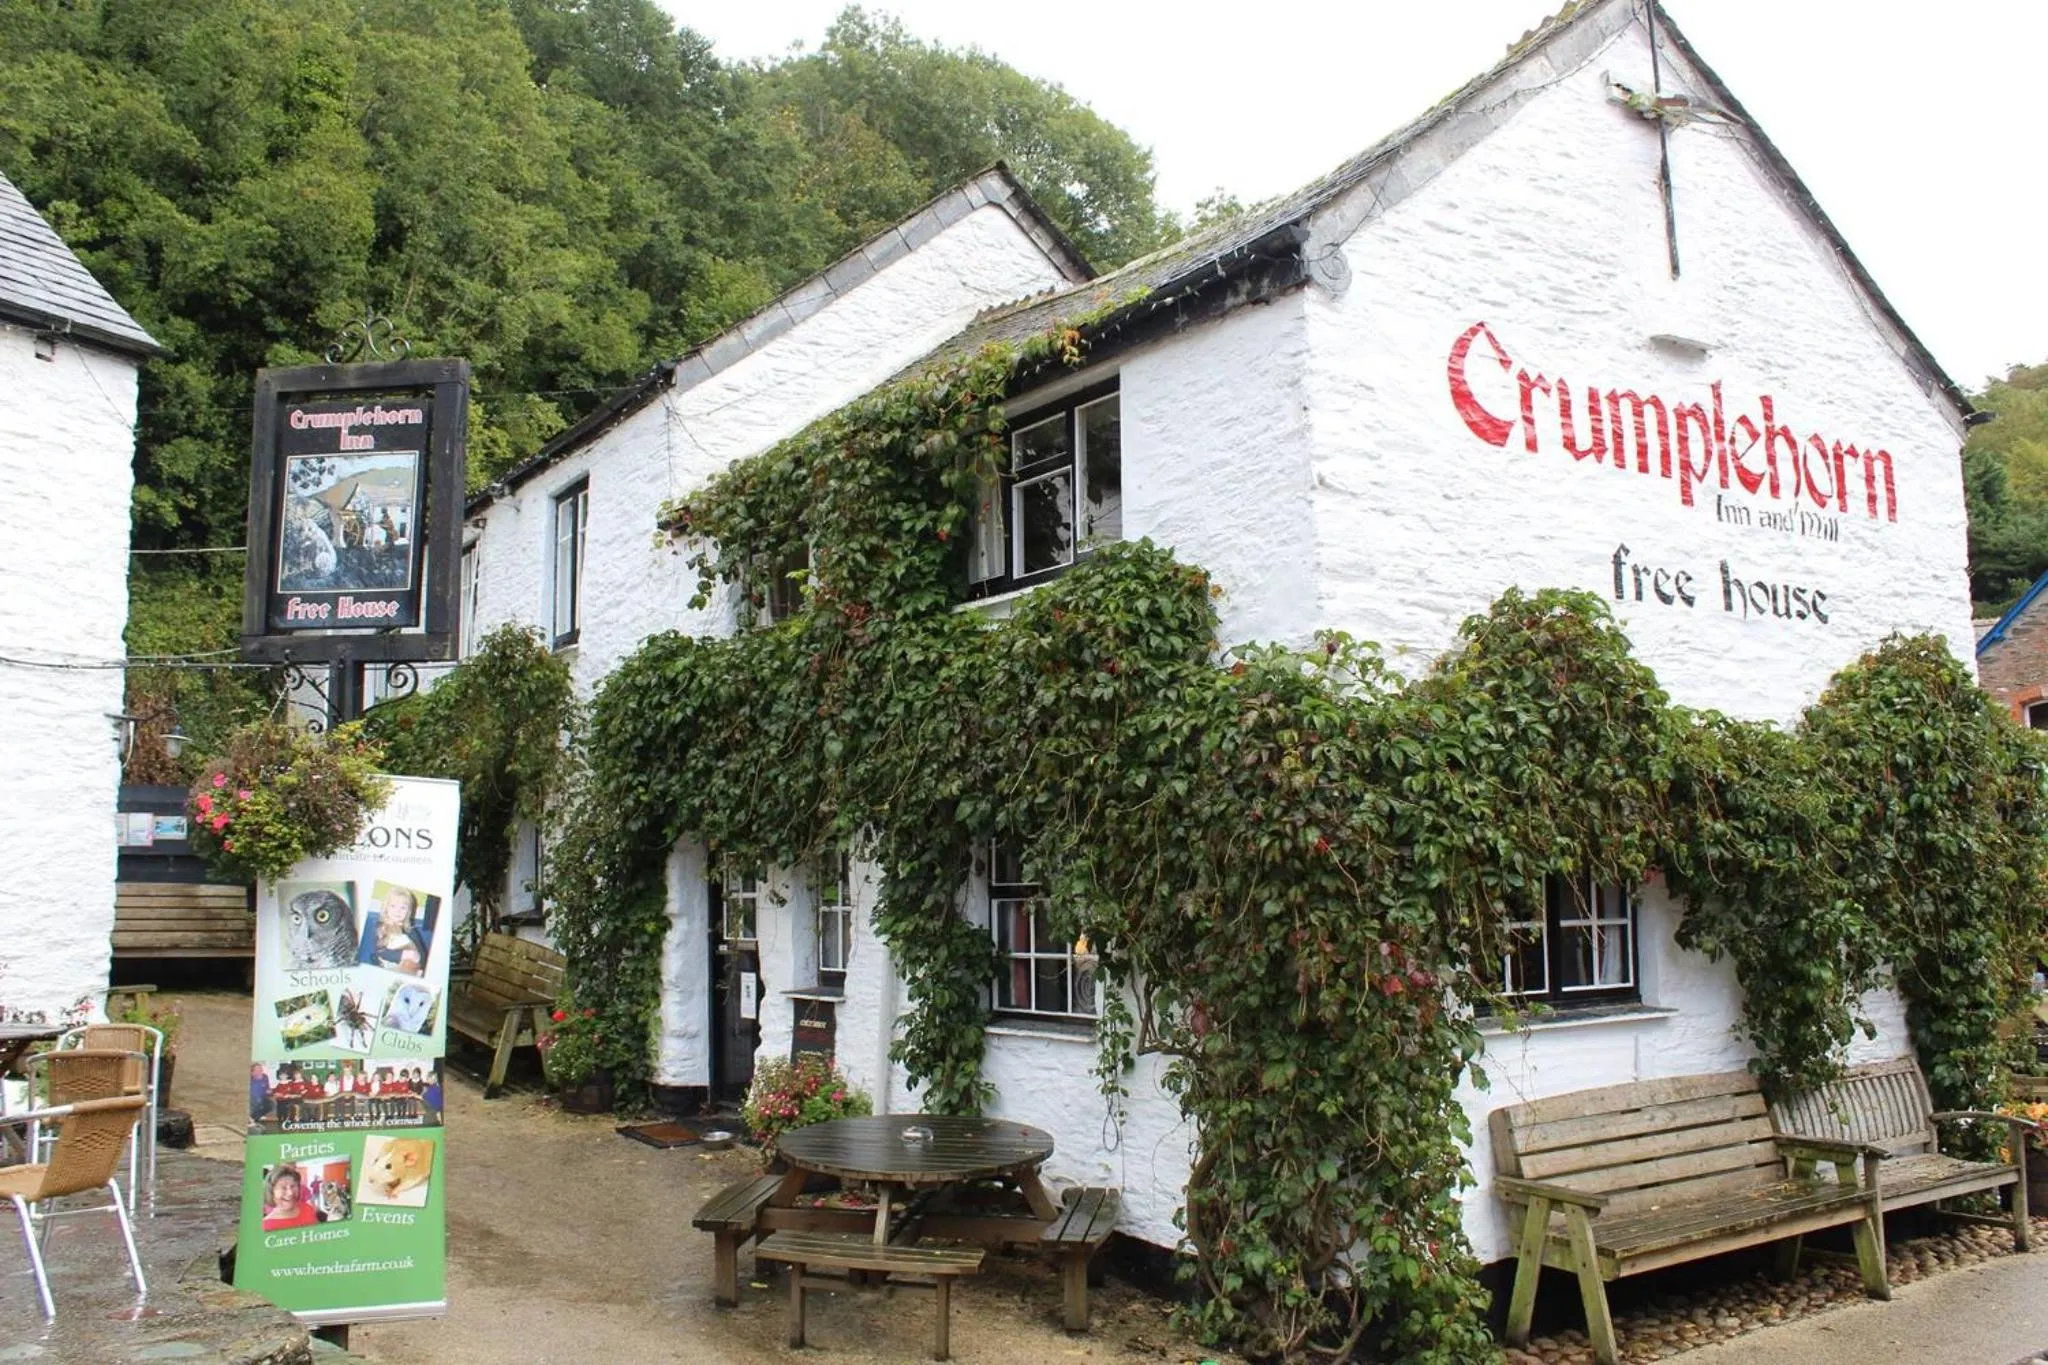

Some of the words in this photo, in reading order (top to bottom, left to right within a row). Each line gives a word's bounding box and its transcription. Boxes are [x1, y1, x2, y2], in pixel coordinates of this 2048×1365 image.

[290, 405, 422, 432] Crumplehorn
[1447, 321, 1897, 523] Crumplehorn
[341, 428, 374, 450] Inn
[1716, 494, 1752, 526] Inn
[1758, 501, 1799, 533] and
[1611, 543, 1696, 609] free
[1719, 559, 1829, 625] house
[338, 595, 400, 619] House
[357, 826, 433, 850] ONS
[289, 968, 352, 988] Schools
[381, 1031, 424, 1052] Clubs
[281, 1118, 325, 1132] Covering
[327, 1118, 341, 1128] the
[343, 1116, 368, 1128] whole
[372, 1115, 384, 1127] of
[280, 1139, 335, 1160] Parties
[361, 1207, 415, 1225] Events
[264, 1234, 298, 1248] Care
[301, 1228, 351, 1244] Homes
[270, 1255, 415, 1278] www.hendrafarm.co.uk
